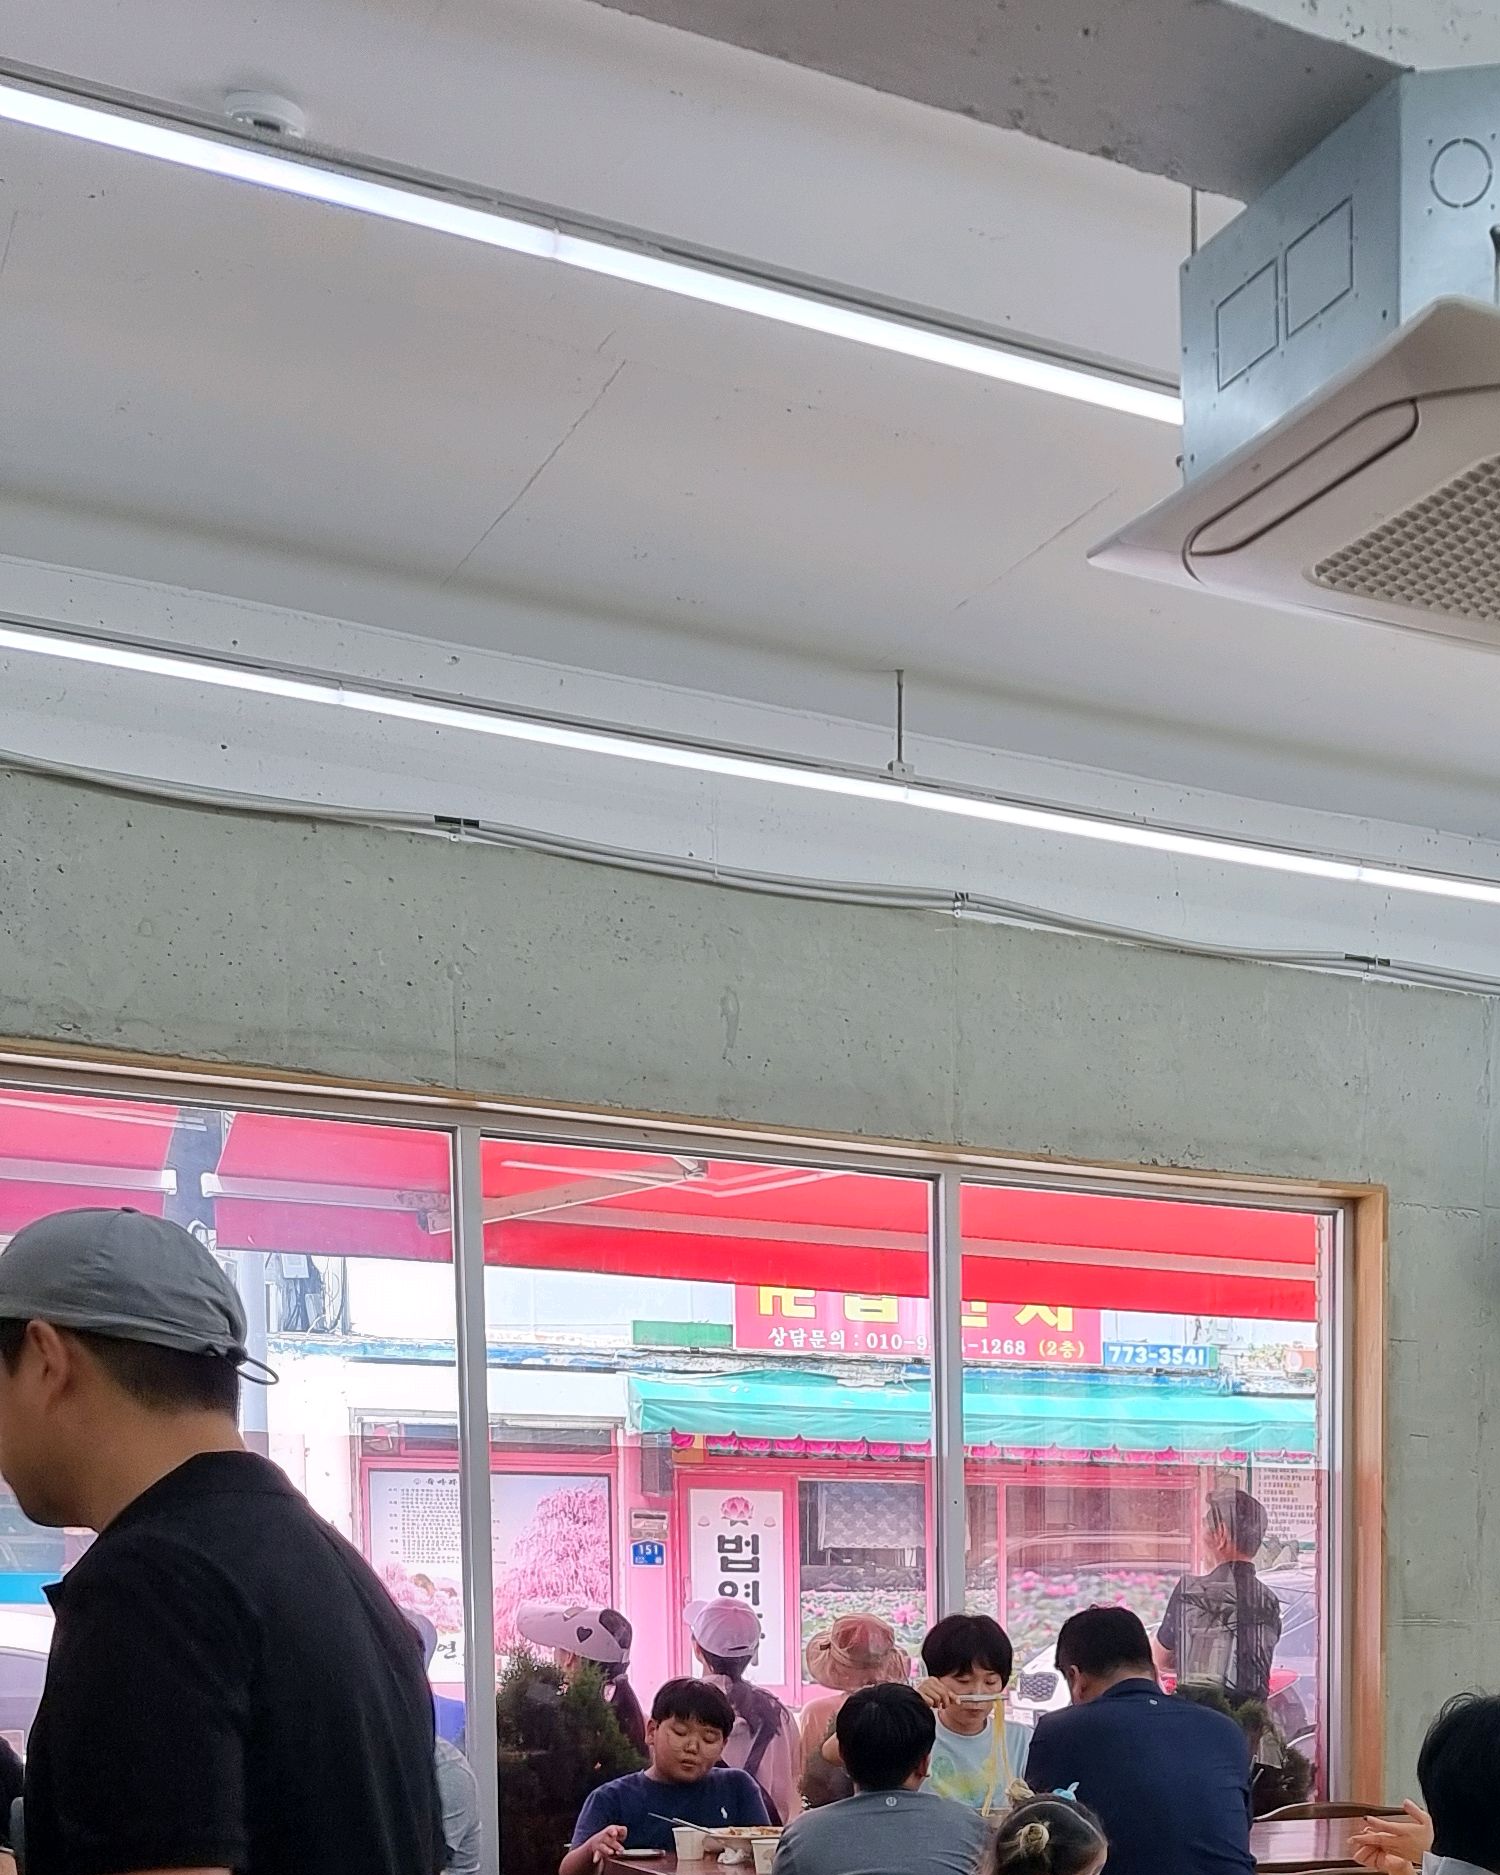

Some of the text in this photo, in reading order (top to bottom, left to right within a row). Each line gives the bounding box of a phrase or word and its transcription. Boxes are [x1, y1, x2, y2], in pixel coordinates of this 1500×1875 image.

[768, 1326, 845, 1350] 상담문의
[1038, 1339, 1085, 1359] (2층)
[1107, 1345, 1205, 1367] 773-3541
[639, 1544, 659, 1556] 151
